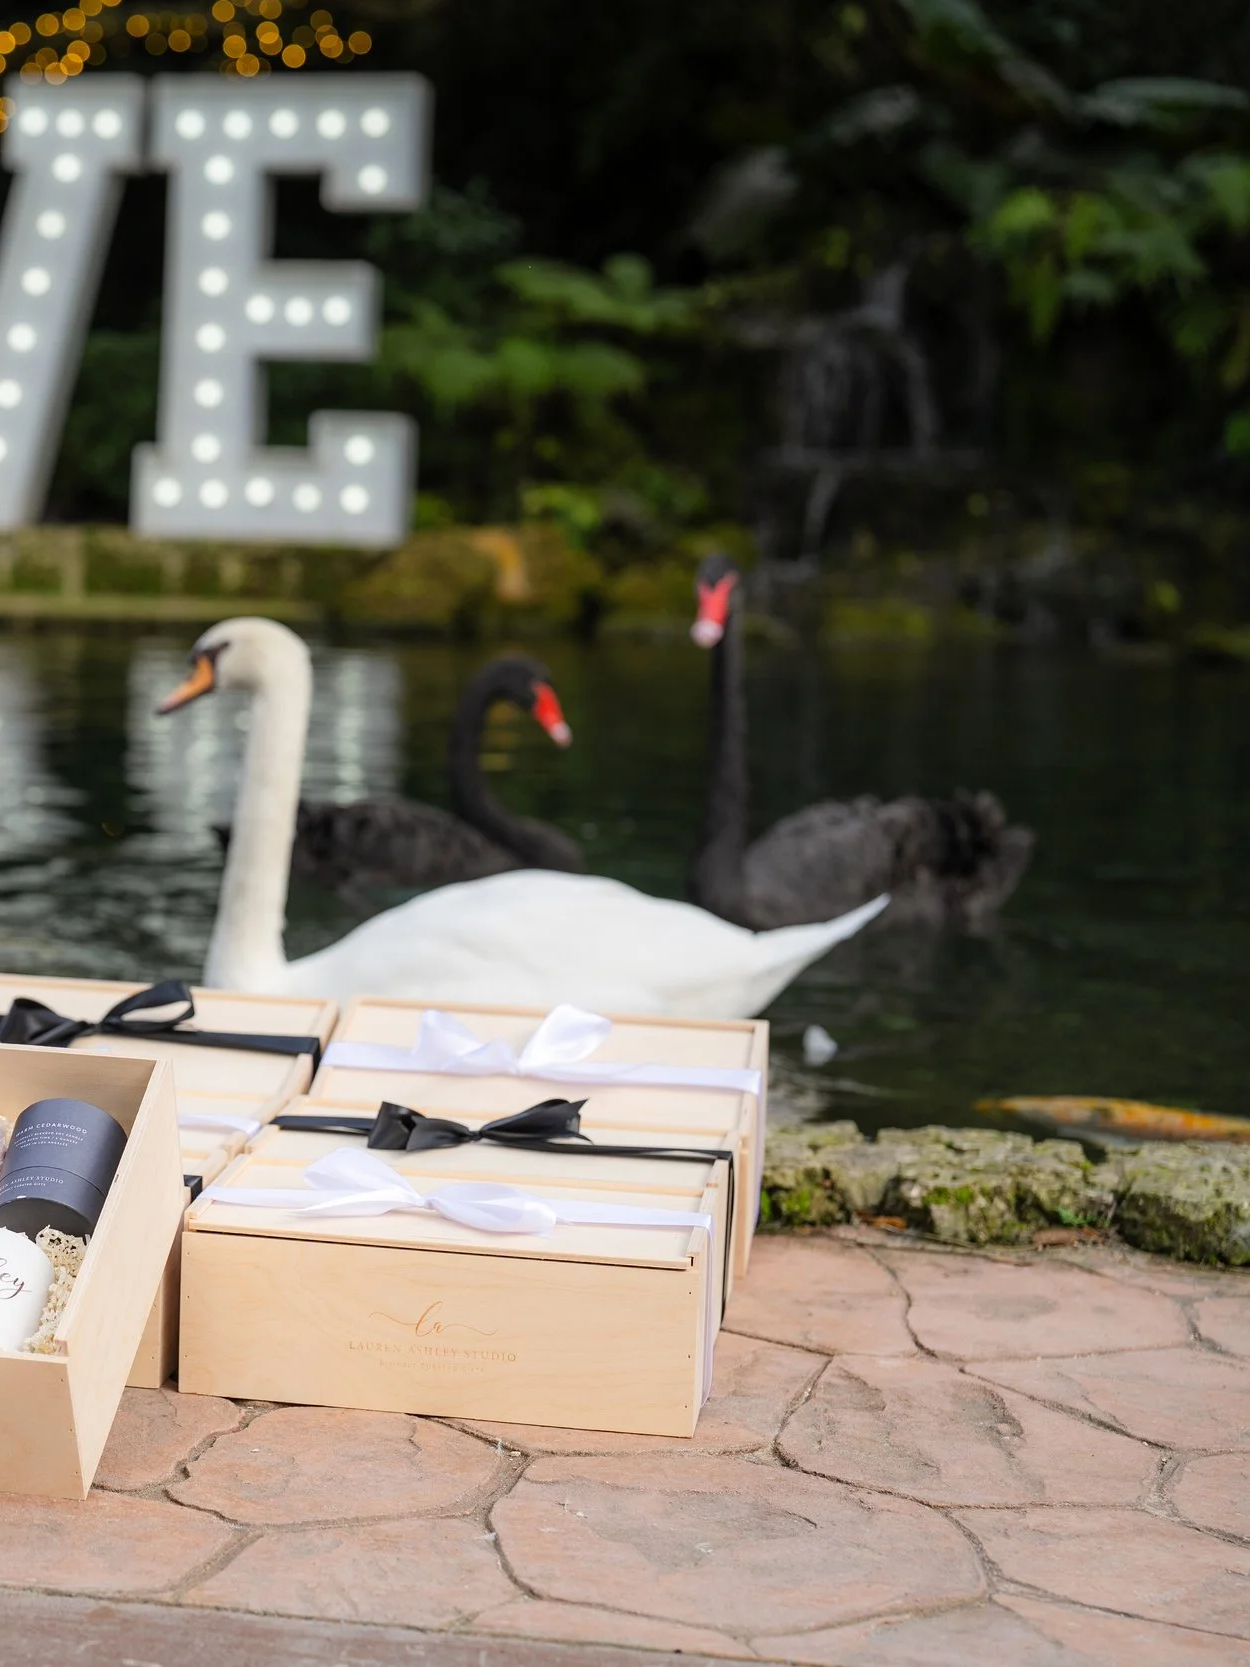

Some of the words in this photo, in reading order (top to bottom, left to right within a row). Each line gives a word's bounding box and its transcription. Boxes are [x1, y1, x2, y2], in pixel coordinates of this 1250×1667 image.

[36, 1122, 88, 1135] CEDARWOOD
[11, 1176, 34, 1184] ASHLEY
[36, 1175, 64, 1184] STUDIO
[349, 1340, 401, 1353] LAUREN
[408, 1345, 459, 1358] ASHLEY
[463, 1350, 517, 1363] STUDIO
